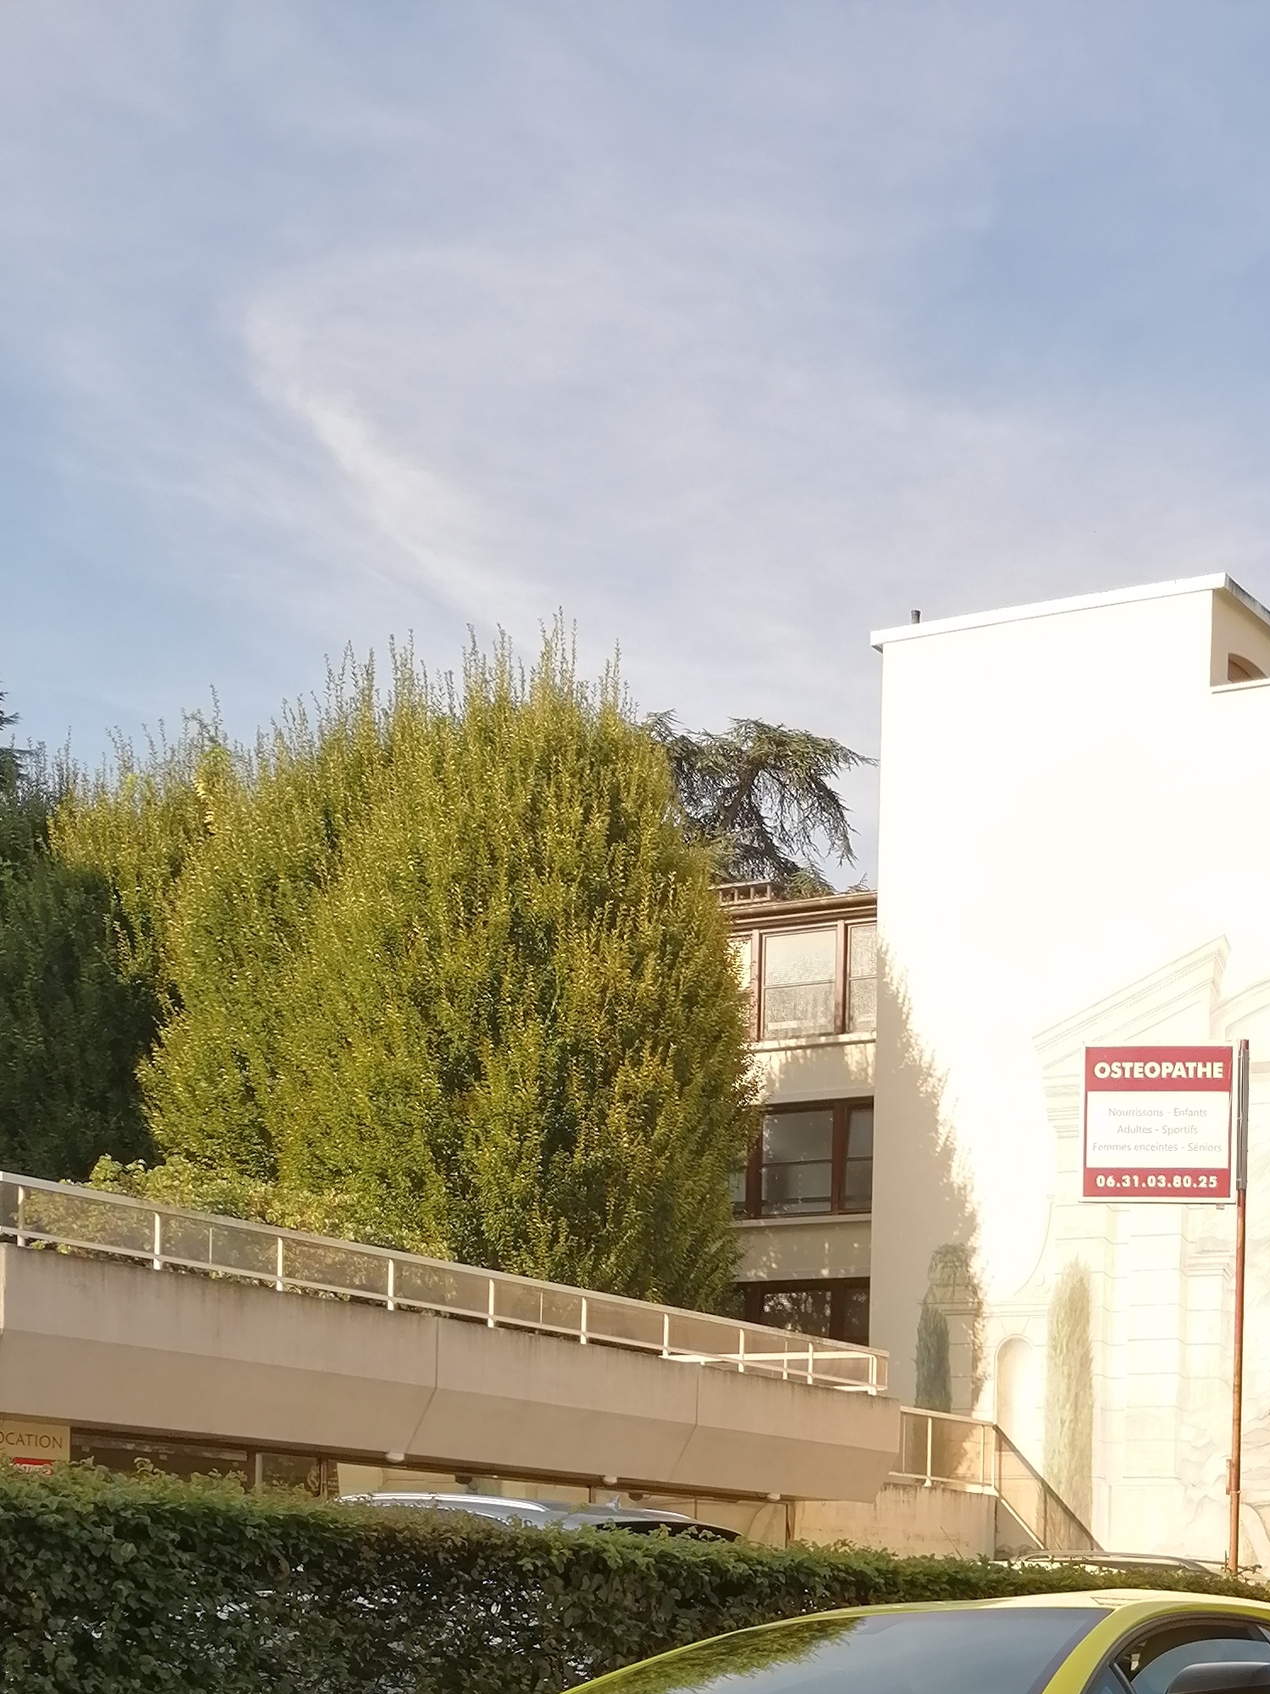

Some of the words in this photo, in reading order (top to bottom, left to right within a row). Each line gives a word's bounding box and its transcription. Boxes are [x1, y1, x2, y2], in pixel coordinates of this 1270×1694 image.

[1093, 1061, 1224, 1079] OSTEOPATHE
[1108, 1108, 1164, 1117] Nourrissons
[1173, 1108, 1207, 1117] Enfants
[1117, 1125, 1152, 1134] Adultes
[1162, 1125, 1198, 1136] Sportifs
[1092, 1142, 1132, 1151] Femmes
[1134, 1142, 1178, 1151] enceintes
[1188, 1142, 1222, 1152] Séniors
[1096, 1175, 1218, 1188] 06.31.03.80.25
